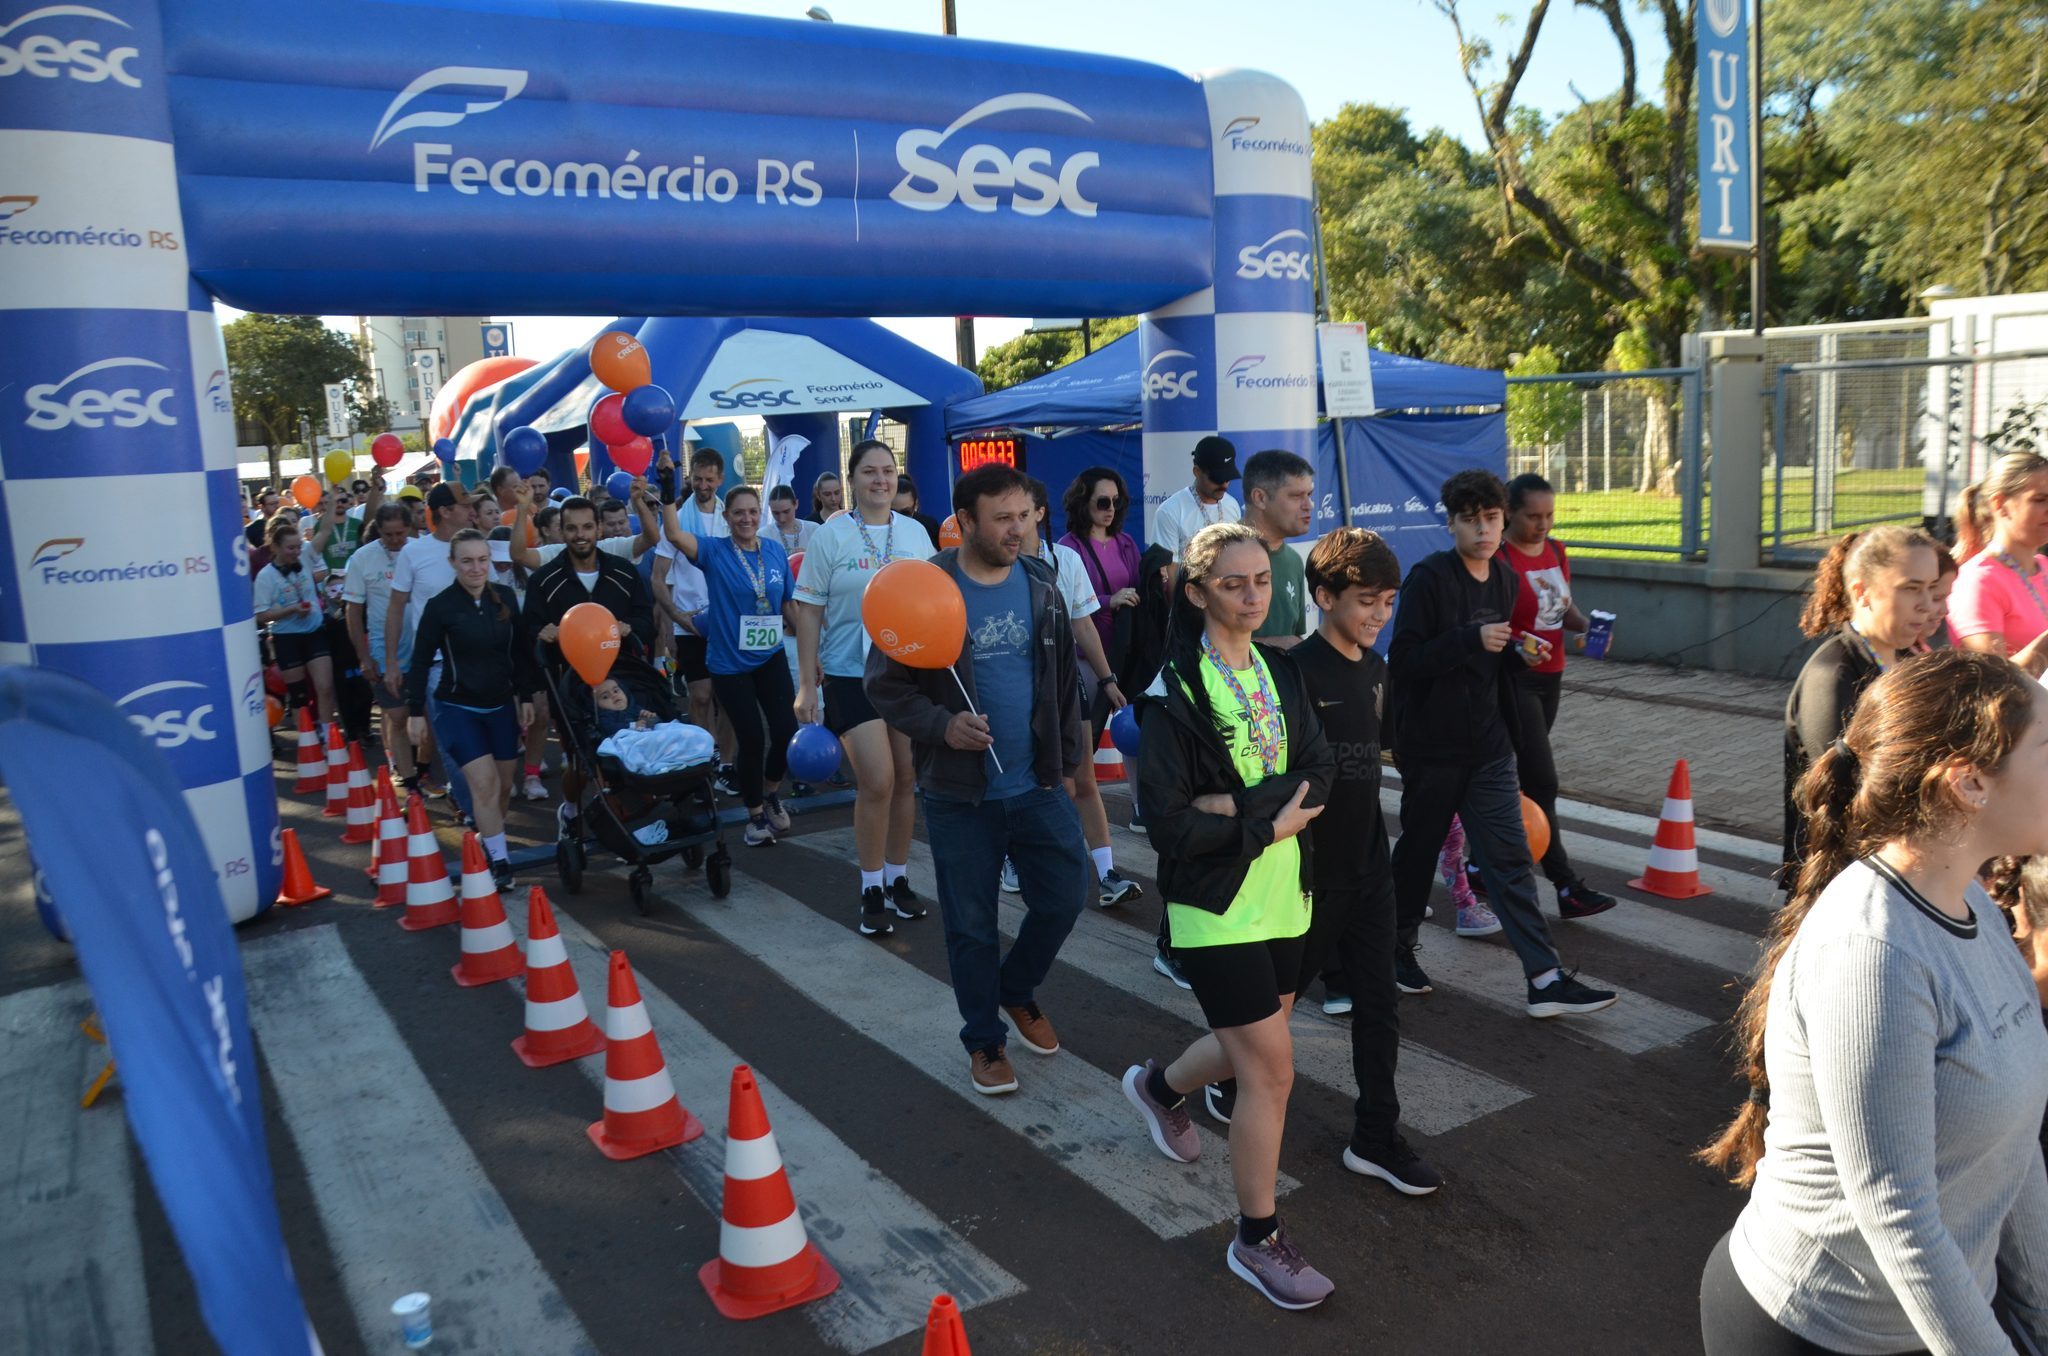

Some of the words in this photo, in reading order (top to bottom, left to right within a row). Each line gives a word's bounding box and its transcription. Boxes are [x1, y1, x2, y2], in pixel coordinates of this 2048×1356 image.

[1708, 49, 1740, 236] URI
[414, 142, 739, 202] Fecomércio
[756, 158, 823, 207] RS
[889, 127, 1099, 217] Sesc
[148, 230, 179, 251] RS
[1236, 245, 1311, 281] Sesc
[709, 389, 802, 410] Sesc
[806, 381, 884, 394] Fecomércio
[814, 394, 857, 405] Senac
[25, 384, 178, 431] Sesc
[331, 401, 343, 434] URI
[1350, 502, 1394, 517] ndicatos
[43, 561, 179, 585] Fecomércio
[185, 556, 211, 575] RS
[746, 628, 777, 647] 520
[225, 857, 250, 878] RS
